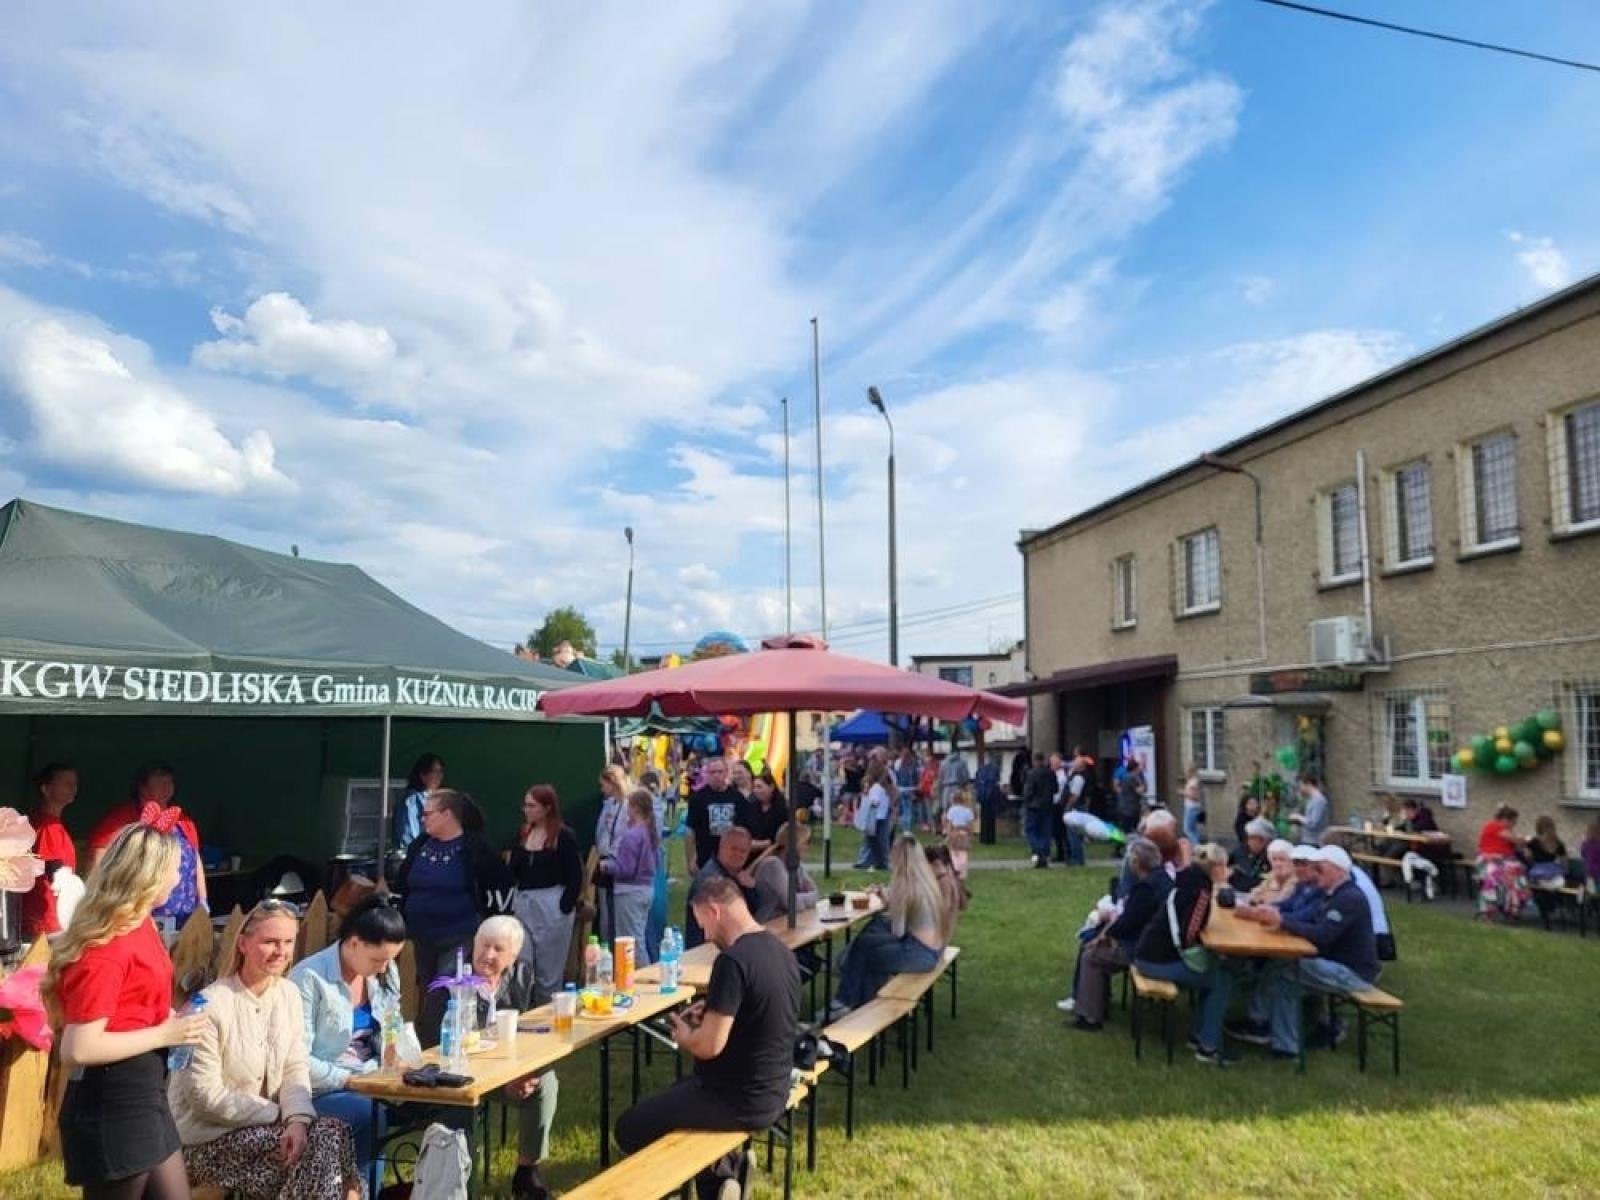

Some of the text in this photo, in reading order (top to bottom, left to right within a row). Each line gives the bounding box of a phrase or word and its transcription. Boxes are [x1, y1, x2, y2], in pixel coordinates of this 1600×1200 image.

[1, 659, 113, 698] KGW
[122, 667, 305, 703] SIEDLISKA
[312, 674, 390, 704] Gmina
[395, 674, 479, 709] KUŹNIA
